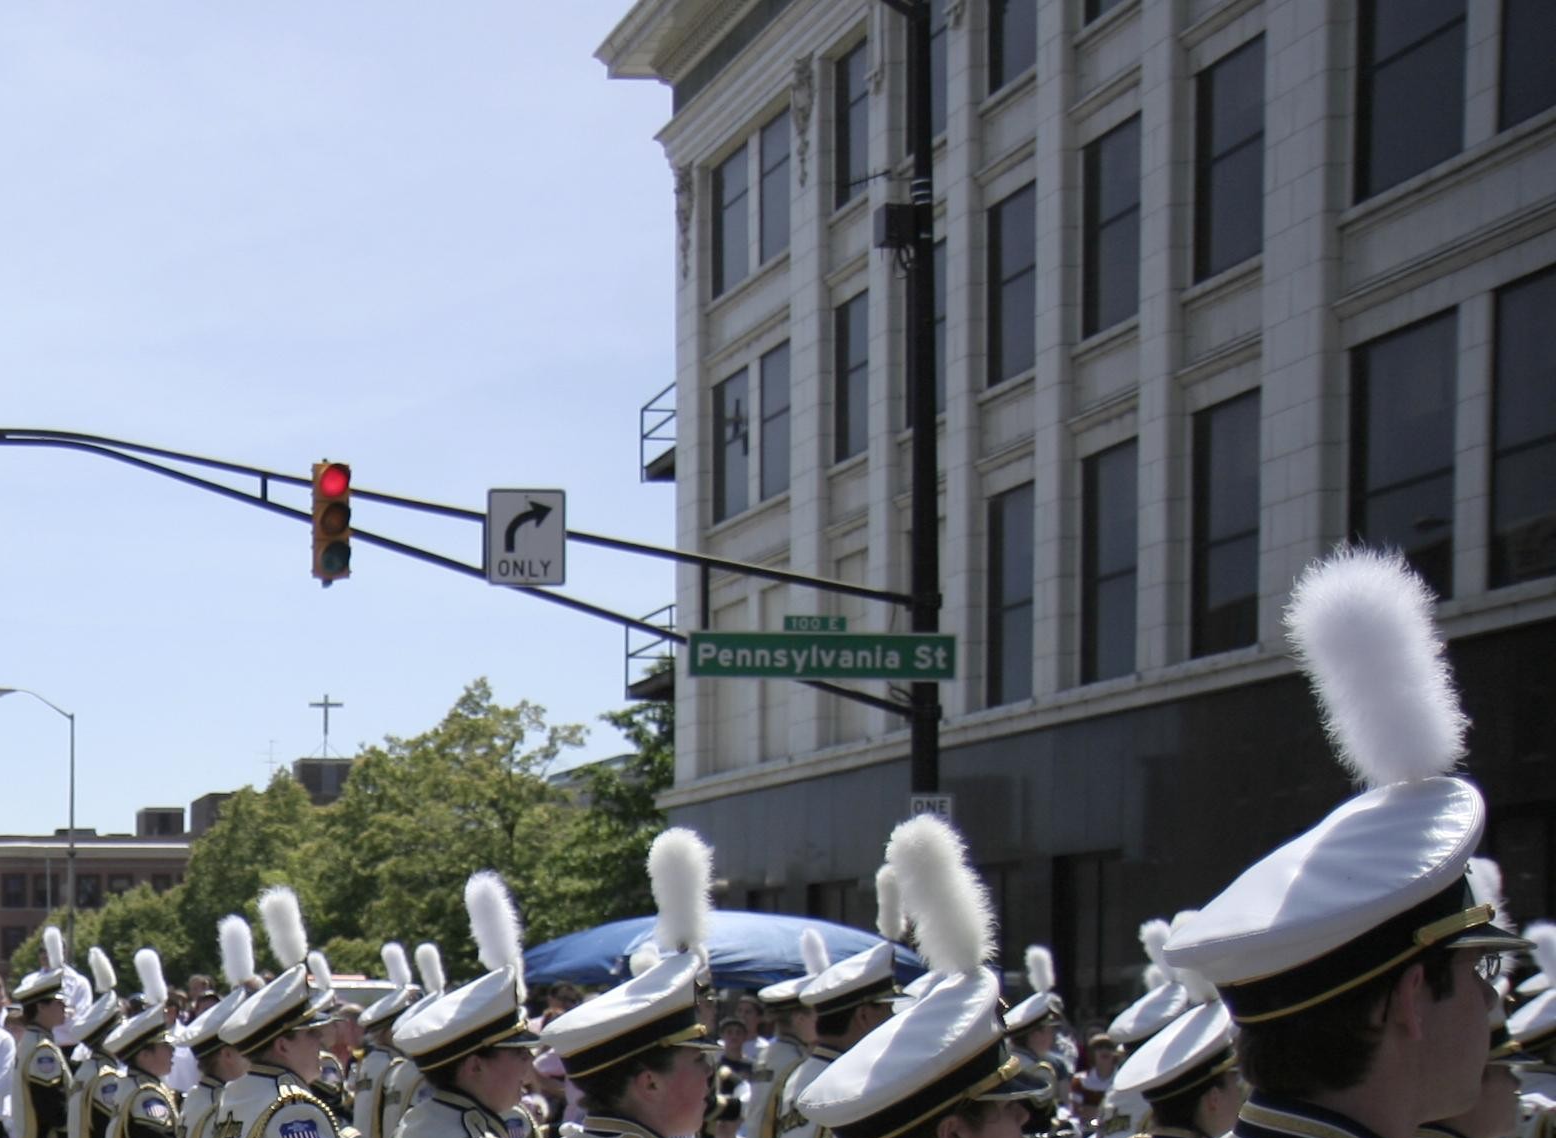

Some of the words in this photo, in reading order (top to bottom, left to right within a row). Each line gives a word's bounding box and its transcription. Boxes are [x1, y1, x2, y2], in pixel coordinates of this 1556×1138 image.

[497, 559, 552, 578] ONLY
[790, 618, 821, 630] 100
[829, 618, 839, 630] E
[697, 643, 900, 674] Pennsylvania
[913, 643, 948, 668] St
[914, 800, 948, 814] ONE
